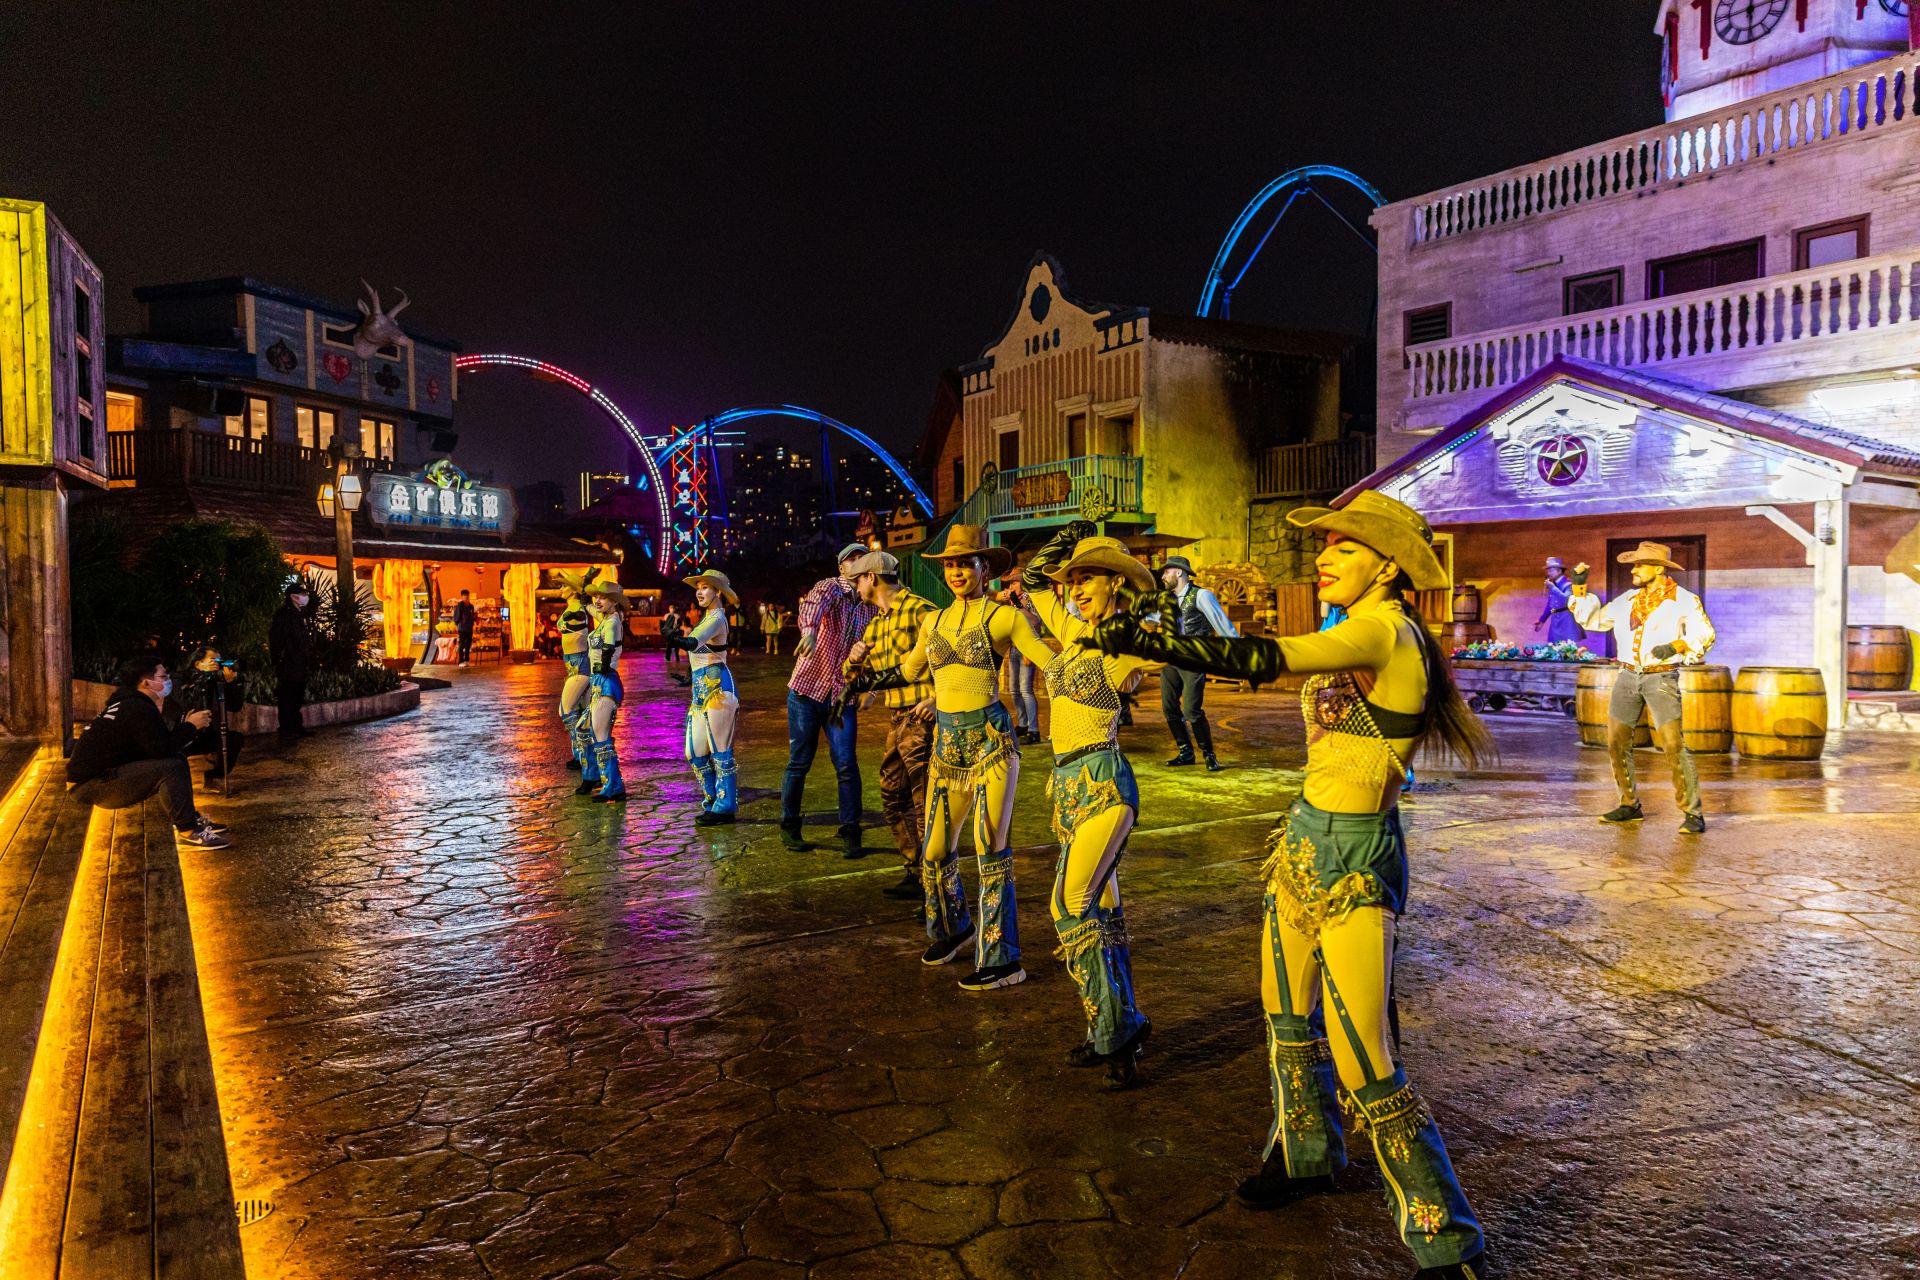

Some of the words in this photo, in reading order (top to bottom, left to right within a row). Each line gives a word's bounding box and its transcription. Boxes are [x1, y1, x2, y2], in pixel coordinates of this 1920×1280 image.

[1025, 327, 1060, 357] 1868
[390, 484, 500, 519] 金矿俱乐部
